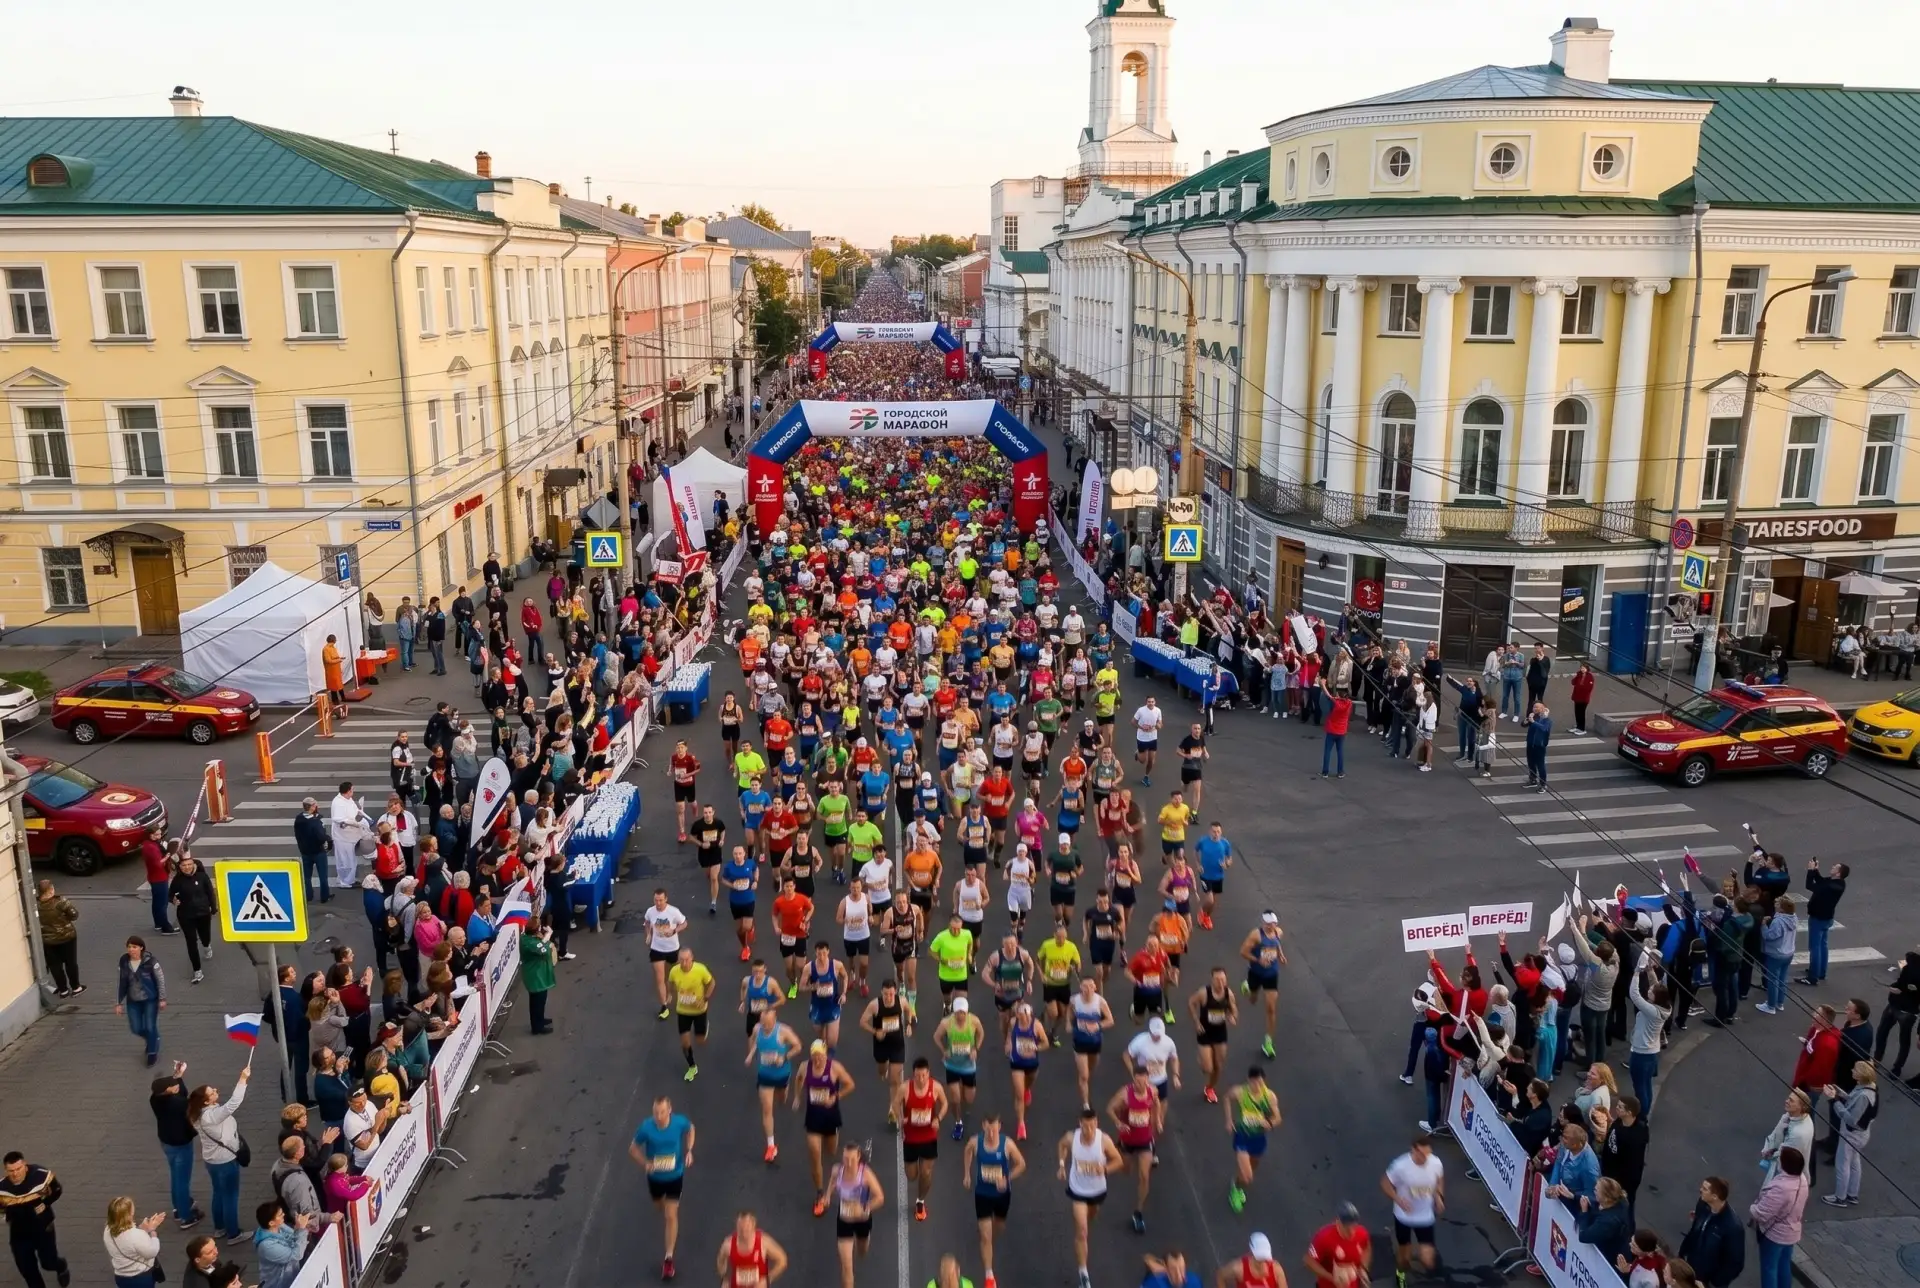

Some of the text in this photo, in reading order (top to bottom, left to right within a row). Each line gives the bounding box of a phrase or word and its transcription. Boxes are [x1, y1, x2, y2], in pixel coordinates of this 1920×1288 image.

[884, 408, 948, 418] ГОРОДСКОЙ
[883, 419, 948, 430] МАРАФОН
[1744, 518, 1862, 538] TARESFOOD
[1472, 909, 1528, 926] ВПЕРЁД!
[1407, 922, 1463, 940] ВПЕРЁД!
